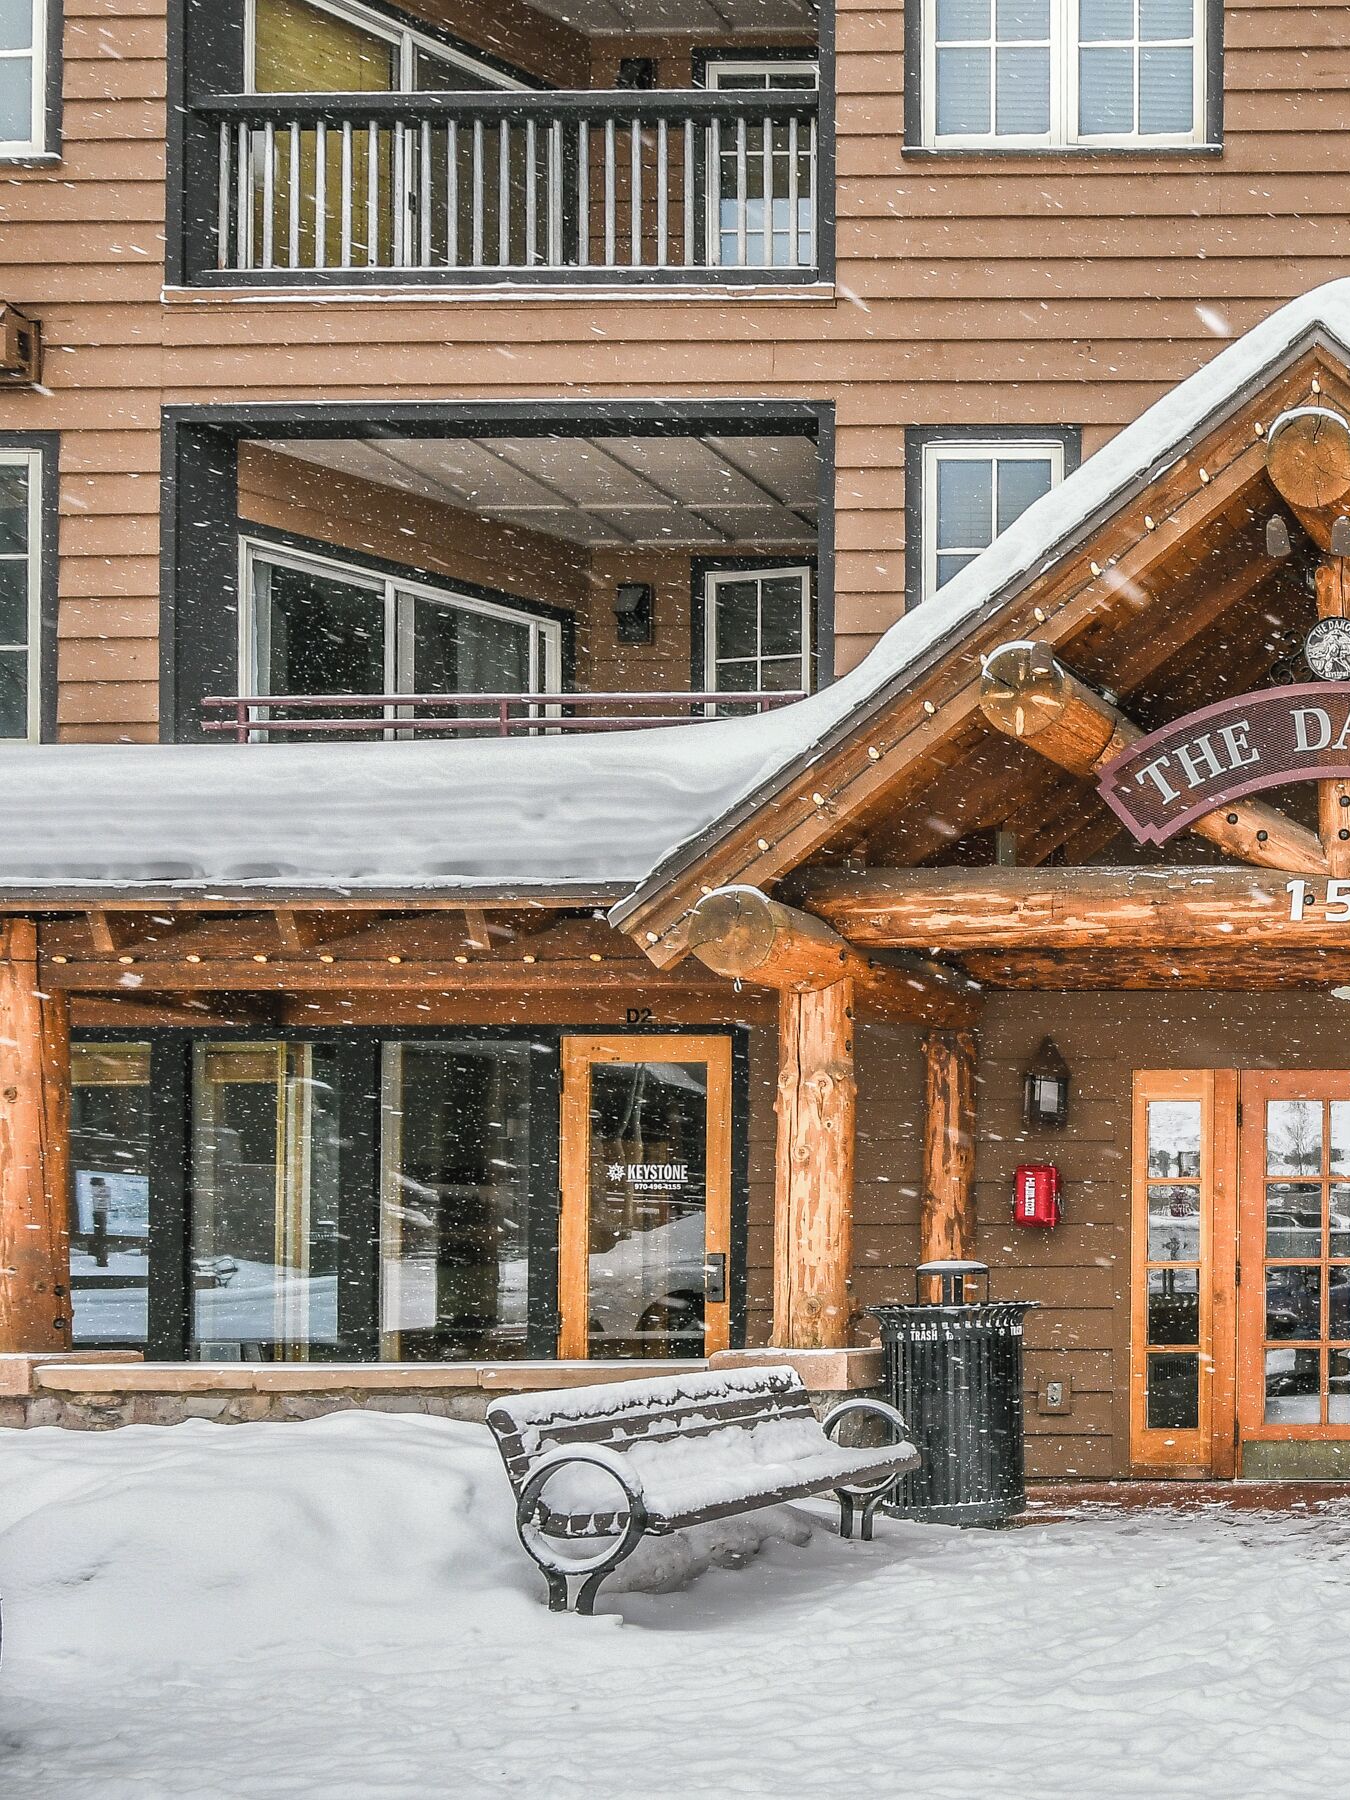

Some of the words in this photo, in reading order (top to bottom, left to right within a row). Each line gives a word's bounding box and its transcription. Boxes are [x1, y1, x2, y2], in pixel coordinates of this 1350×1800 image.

[1313, 623, 1328, 638] THE
[1135, 720, 1260, 806] THE
[626, 1008, 652, 1023] D2
[627, 1164, 688, 1180] KEYSTONE
[910, 1330, 938, 1341] TRASH
